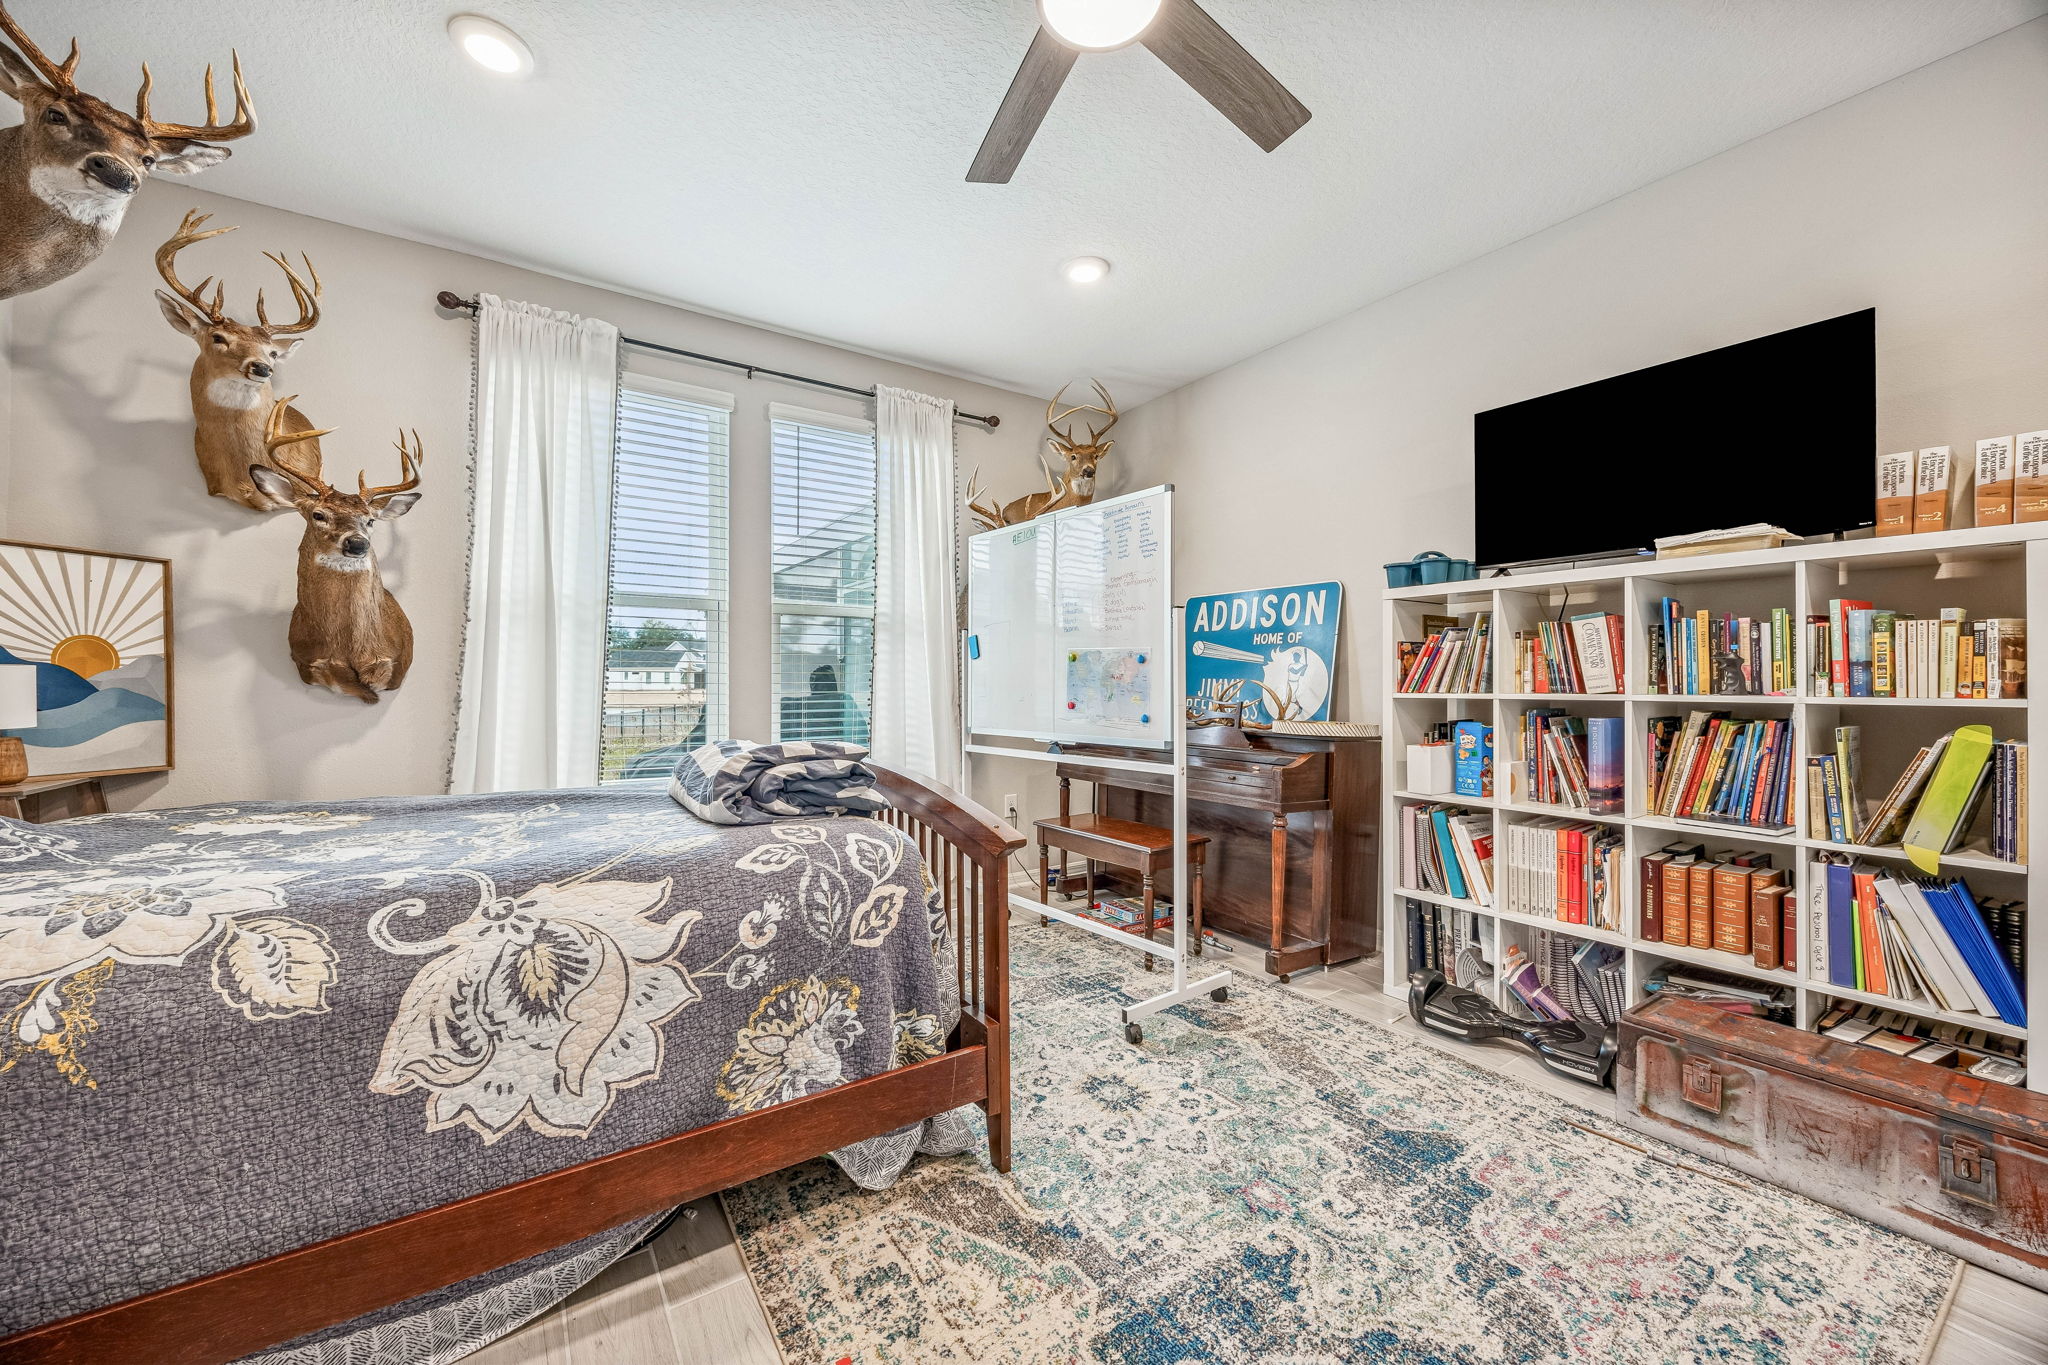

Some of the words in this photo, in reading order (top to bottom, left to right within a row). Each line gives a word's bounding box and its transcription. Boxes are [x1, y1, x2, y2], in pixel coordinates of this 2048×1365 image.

[1997, 504, 2007, 513] 4
[2038, 500, 2048, 509] 5
[1898, 515, 1904, 524] 1
[1933, 512, 1942, 520] 2
[1194, 590, 1326, 632] ADDISON
[1253, 632, 1284, 645] HOME
[1287, 632, 1302, 644] OF
[1581, 621, 1601, 668] COMMENTARY
[1198, 678, 1242, 697] JIMMY
[1823, 759, 1837, 797] INDESCRIBABLE
[1664, 771, 1680, 811] CARTOGRAPHY
[1814, 946, 1823, 964] Cycle
